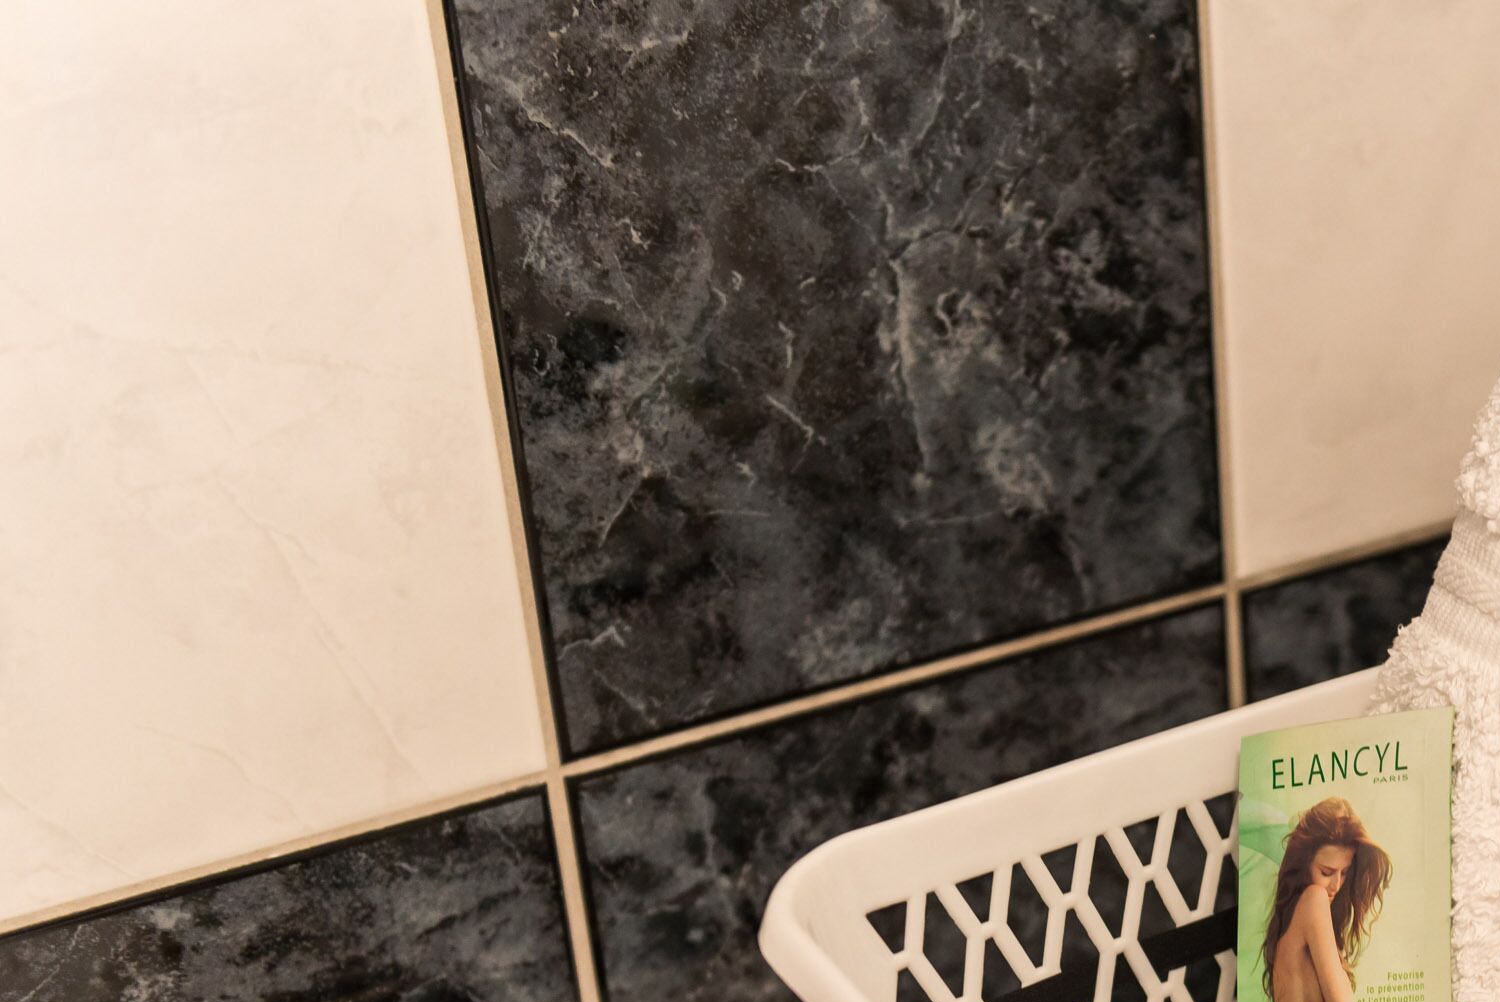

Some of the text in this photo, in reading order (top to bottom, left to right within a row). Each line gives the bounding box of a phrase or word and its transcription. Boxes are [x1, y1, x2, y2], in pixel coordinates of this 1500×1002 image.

[1271, 741, 1408, 790] ELANCYL
[1373, 774, 1409, 785] PARIS
[1387, 970, 1424, 981] Favorise
